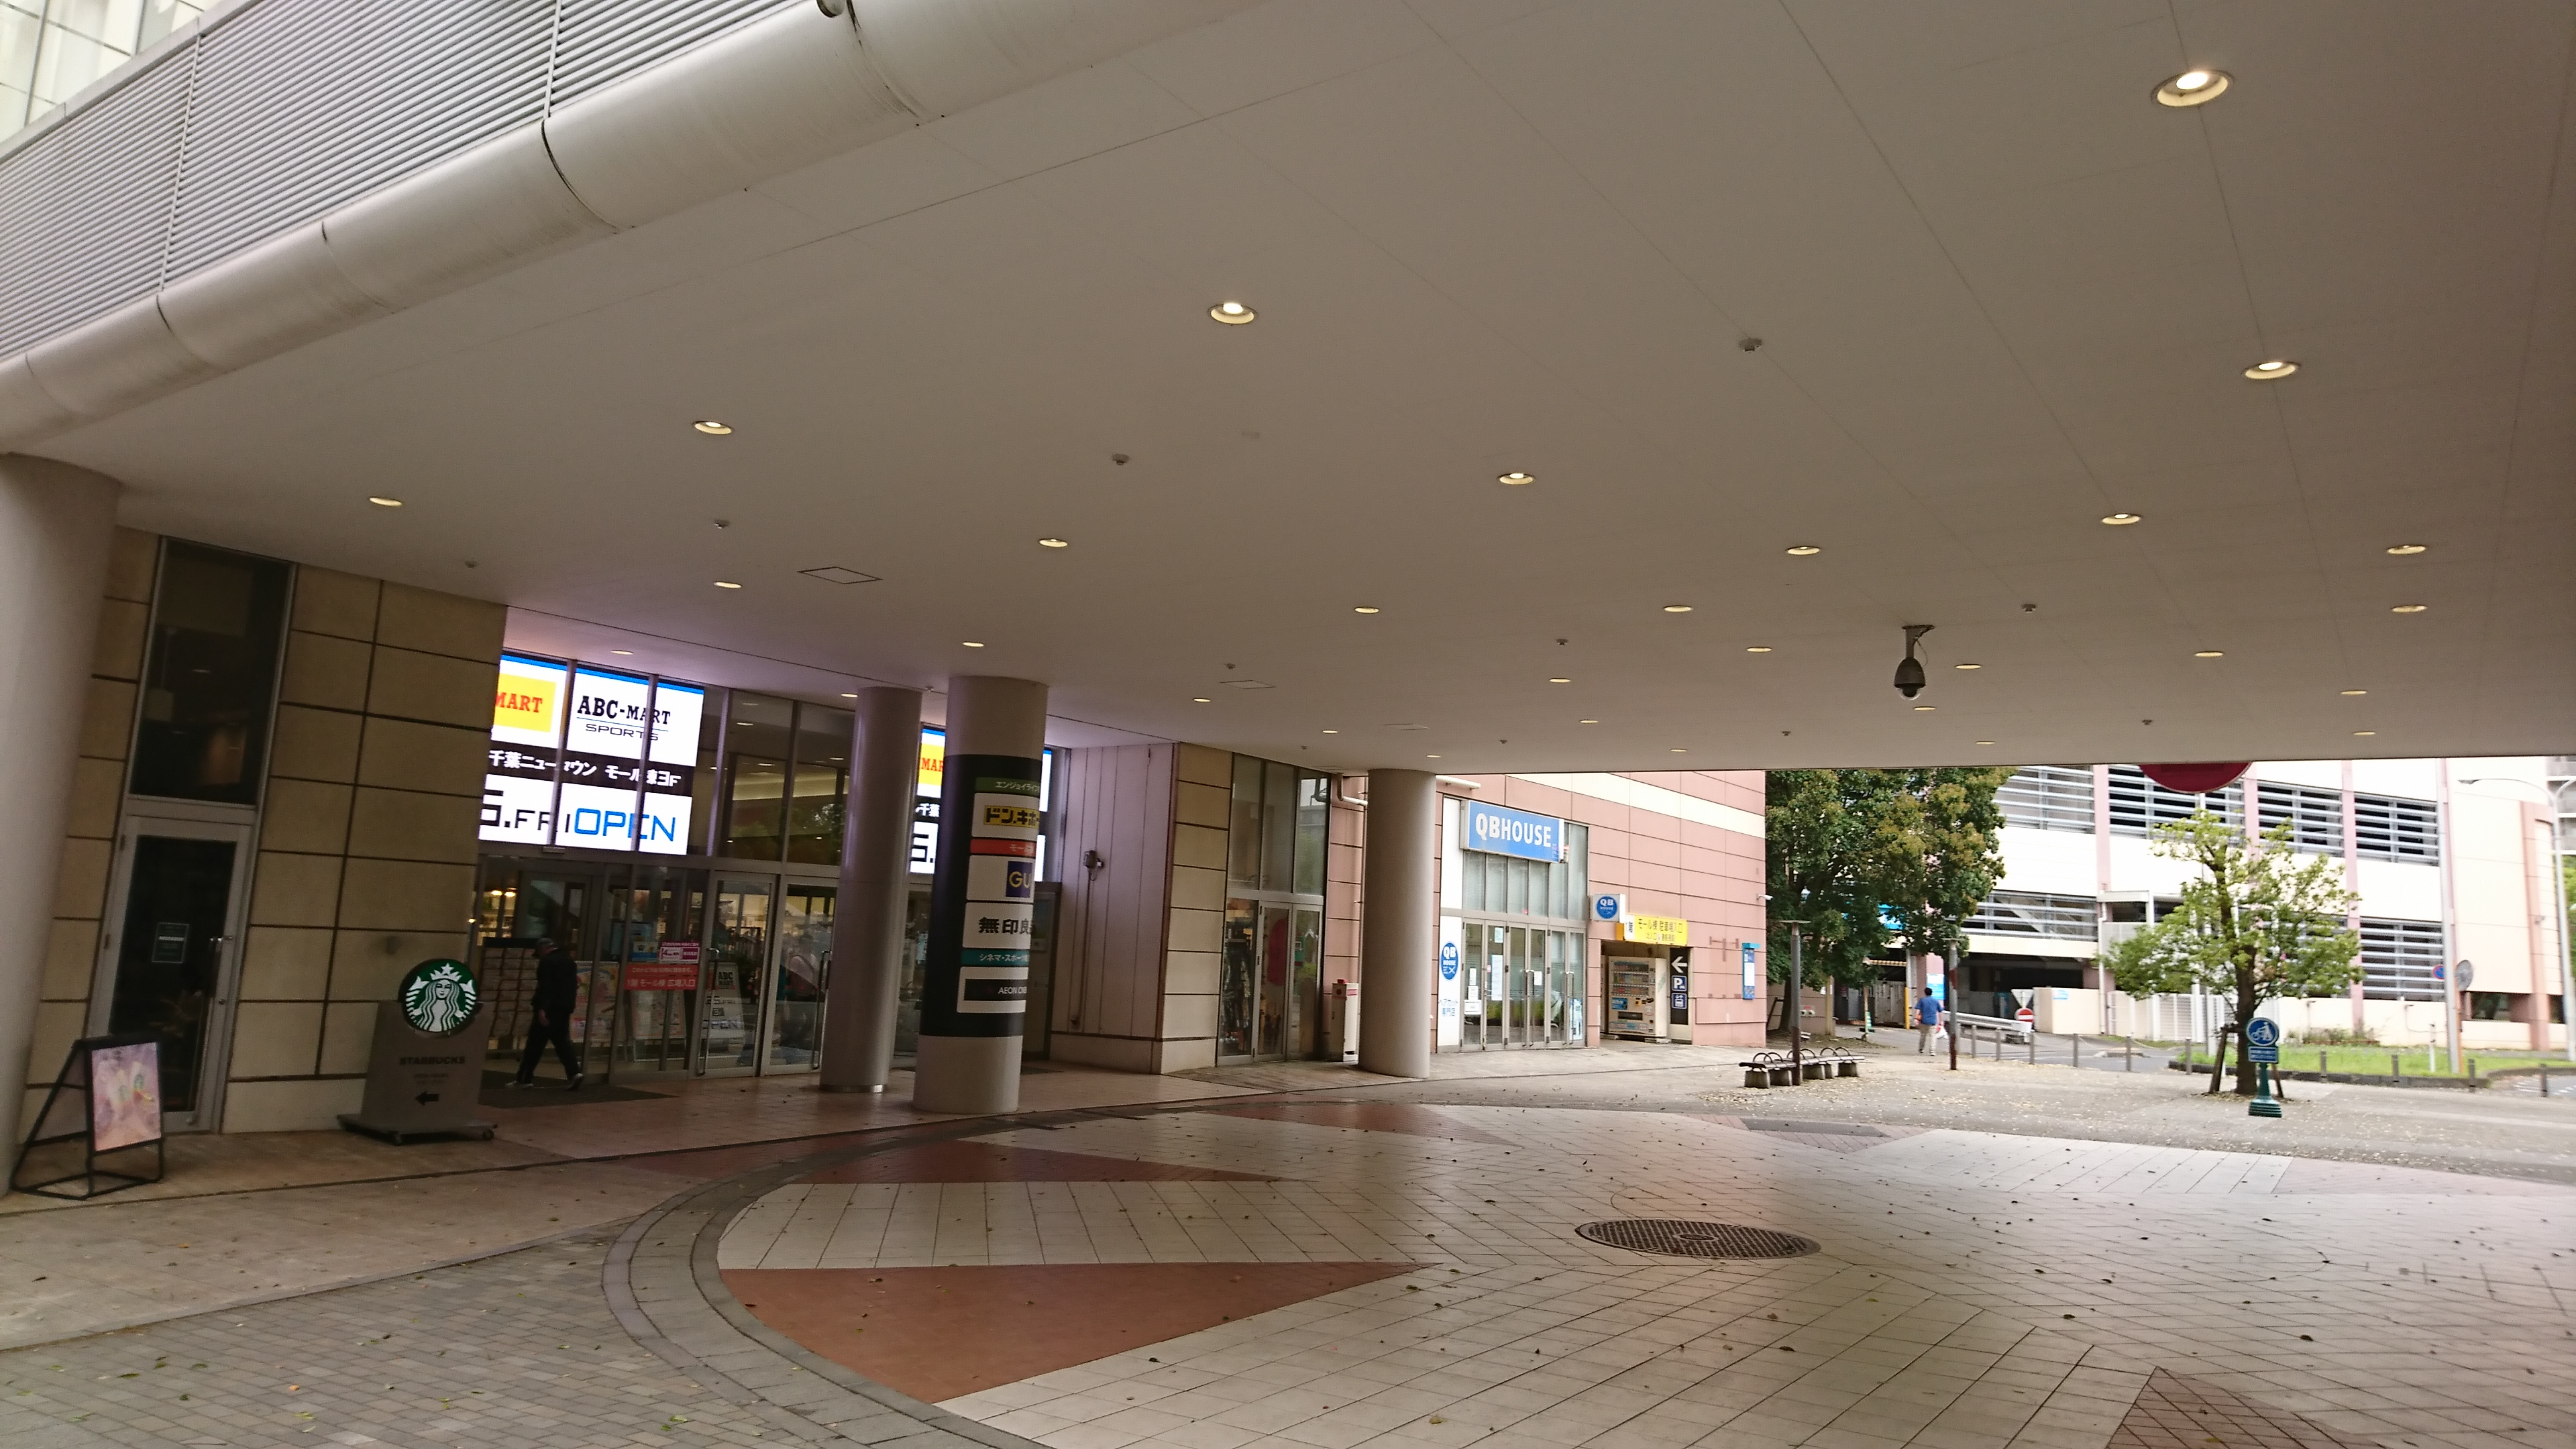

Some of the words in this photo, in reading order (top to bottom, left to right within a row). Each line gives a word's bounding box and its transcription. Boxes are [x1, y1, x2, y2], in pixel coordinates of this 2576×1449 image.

[985, 807, 1040, 826] ドン.キホ
[574, 808, 676, 842] OPEN
[1008, 871, 1032, 889] GU
[1599, 898, 1614, 906] QB
[978, 916, 1032, 934] 無印良
[1442, 946, 1456, 959] QB
[998, 986, 1018, 994] AEON
[399, 1056, 466, 1065] STARBUCKS
